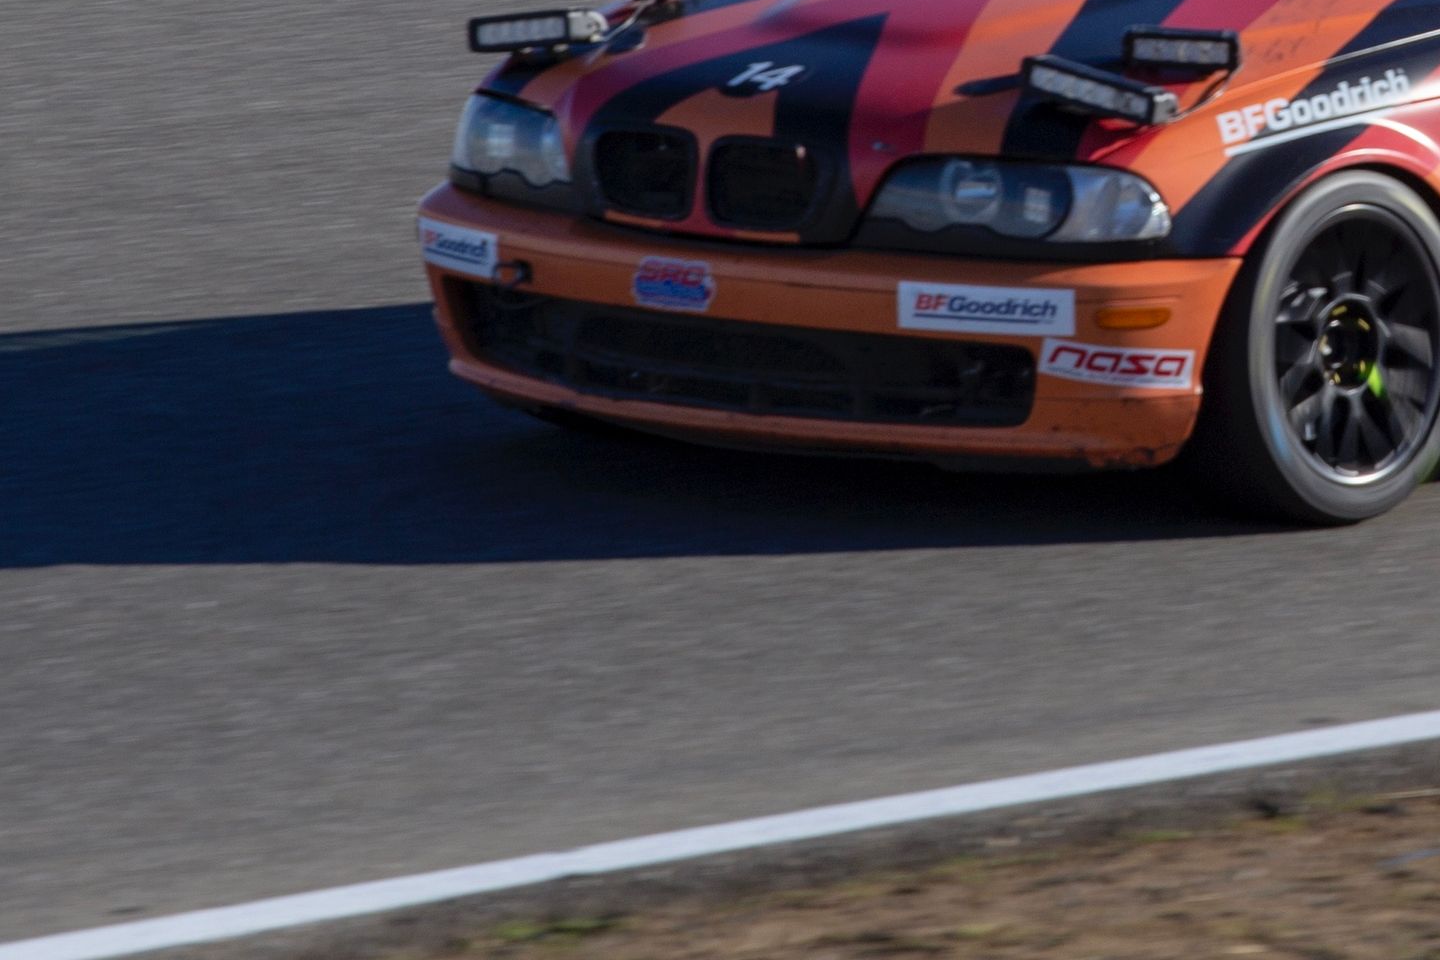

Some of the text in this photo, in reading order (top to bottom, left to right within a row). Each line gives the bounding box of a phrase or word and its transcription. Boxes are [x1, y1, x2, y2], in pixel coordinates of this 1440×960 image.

[726, 61, 805, 91] 14
[1216, 68, 1411, 144] BFGoodrich
[914, 293, 1058, 319] BFGoodrich
